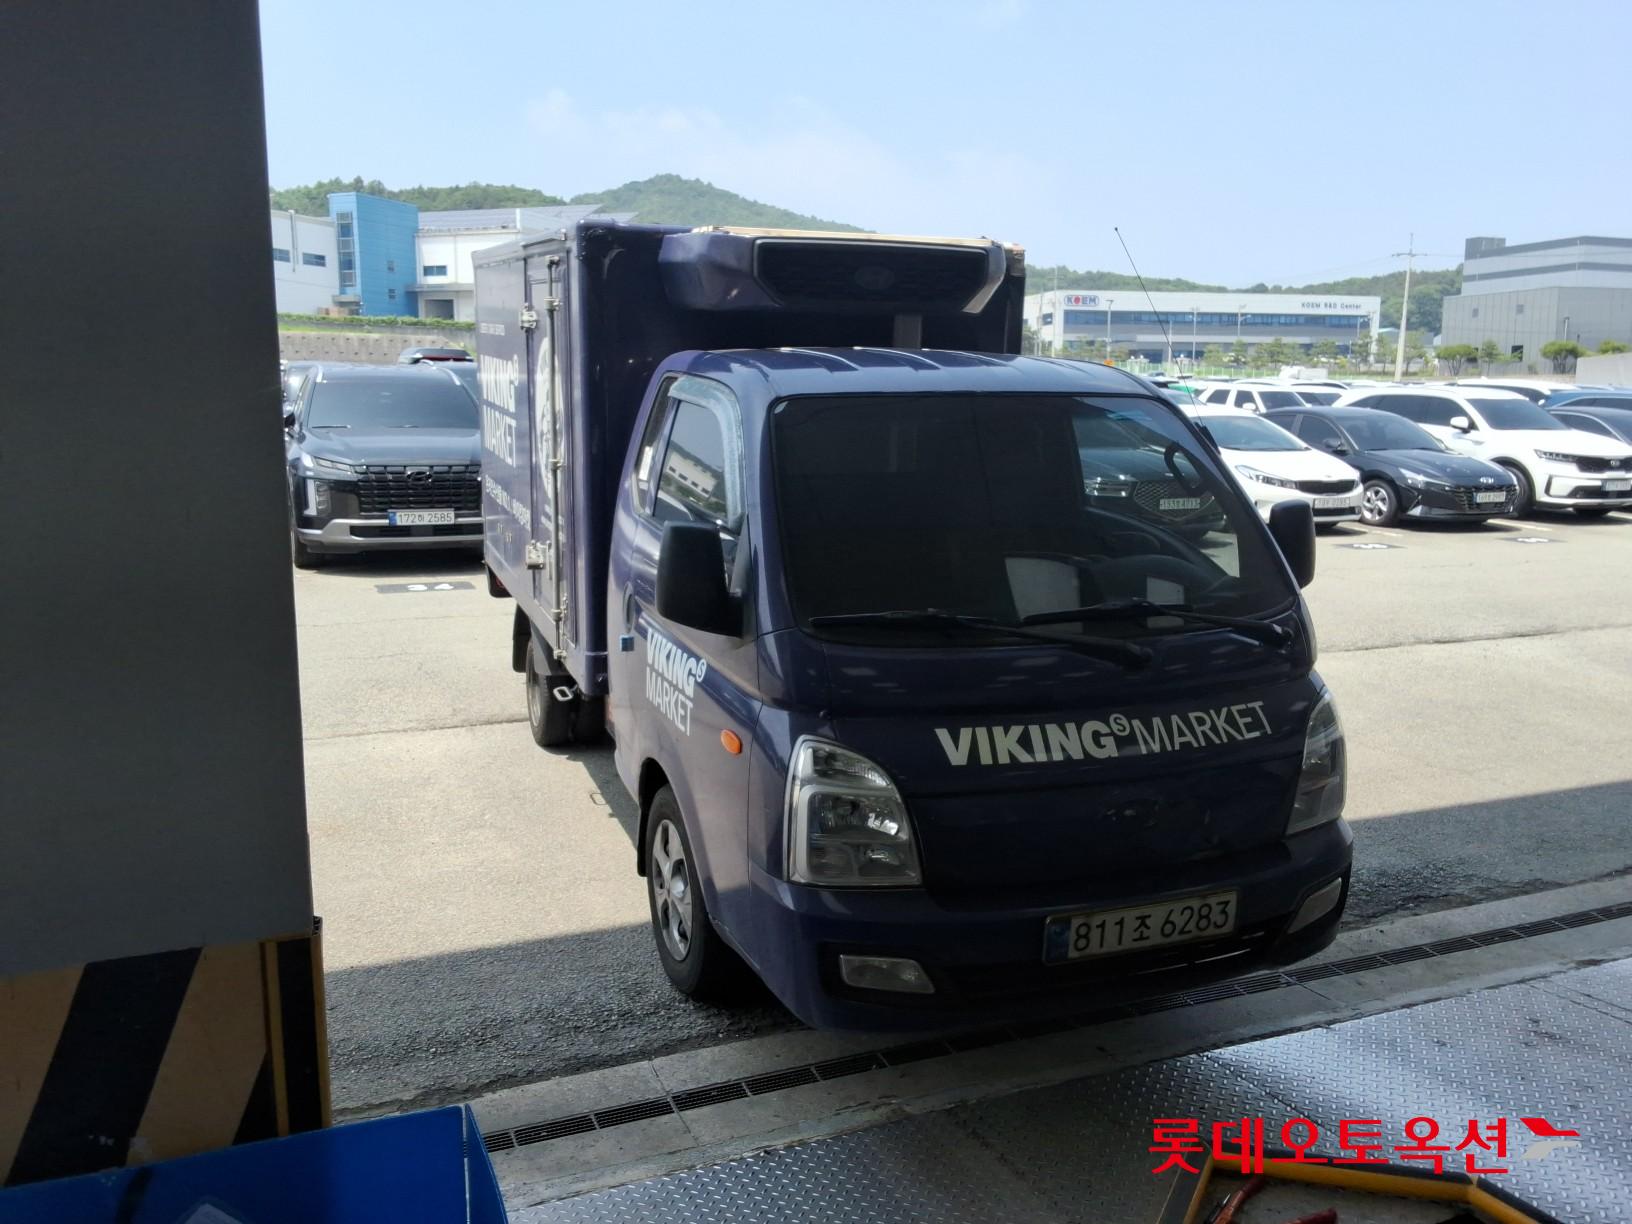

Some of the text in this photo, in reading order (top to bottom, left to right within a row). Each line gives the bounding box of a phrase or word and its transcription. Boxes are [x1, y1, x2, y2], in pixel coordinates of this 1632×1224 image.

[1066, 295, 1097, 305] KOEM
[483, 404, 517, 468] MARKET
[427, 511, 453, 523] 2585
[645, 665, 694, 737] MARKET
[1130, 700, 1273, 755] MARKET
[1073, 900, 1232, 952] 811조 6283
